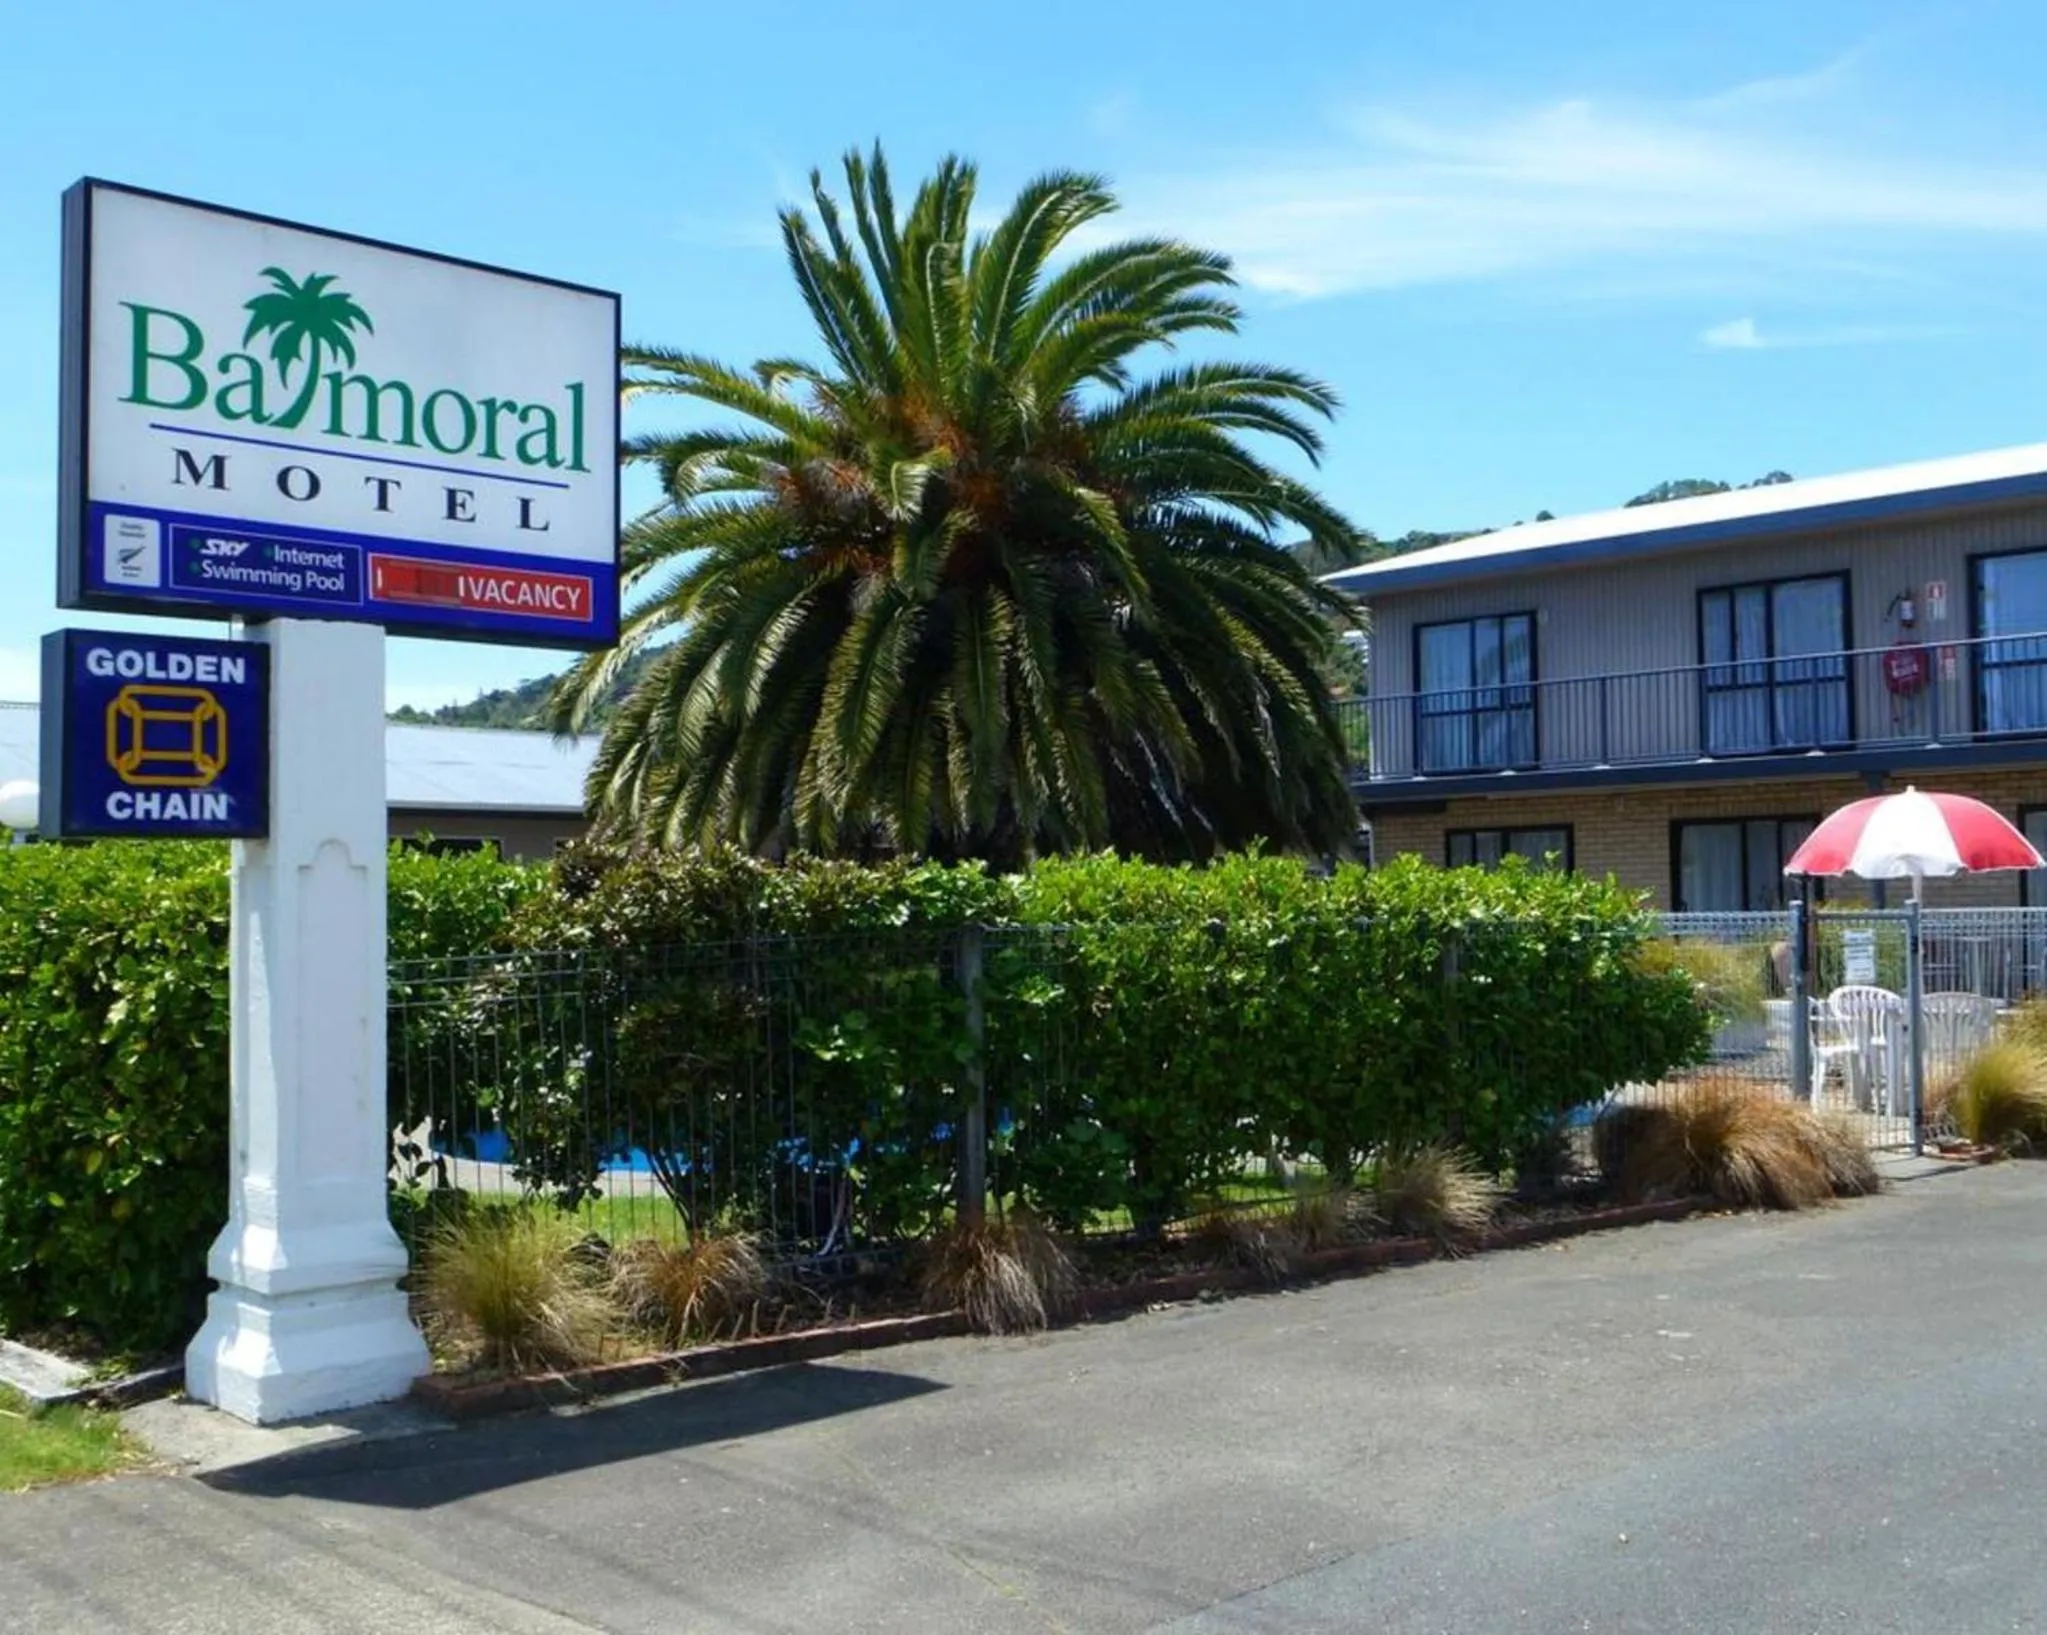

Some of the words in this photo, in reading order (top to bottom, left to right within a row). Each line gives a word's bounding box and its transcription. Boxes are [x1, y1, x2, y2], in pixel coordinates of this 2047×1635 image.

[172, 448, 551, 533] MOTEL
[201, 538, 250, 556] SKY
[274, 544, 345, 569] Internet
[202, 560, 302, 592] Swimming
[304, 571, 345, 591] Pool
[467, 576, 582, 610] VACANCY
[86, 647, 246, 683] GOLDEN
[106, 791, 229, 820] CHAIN
